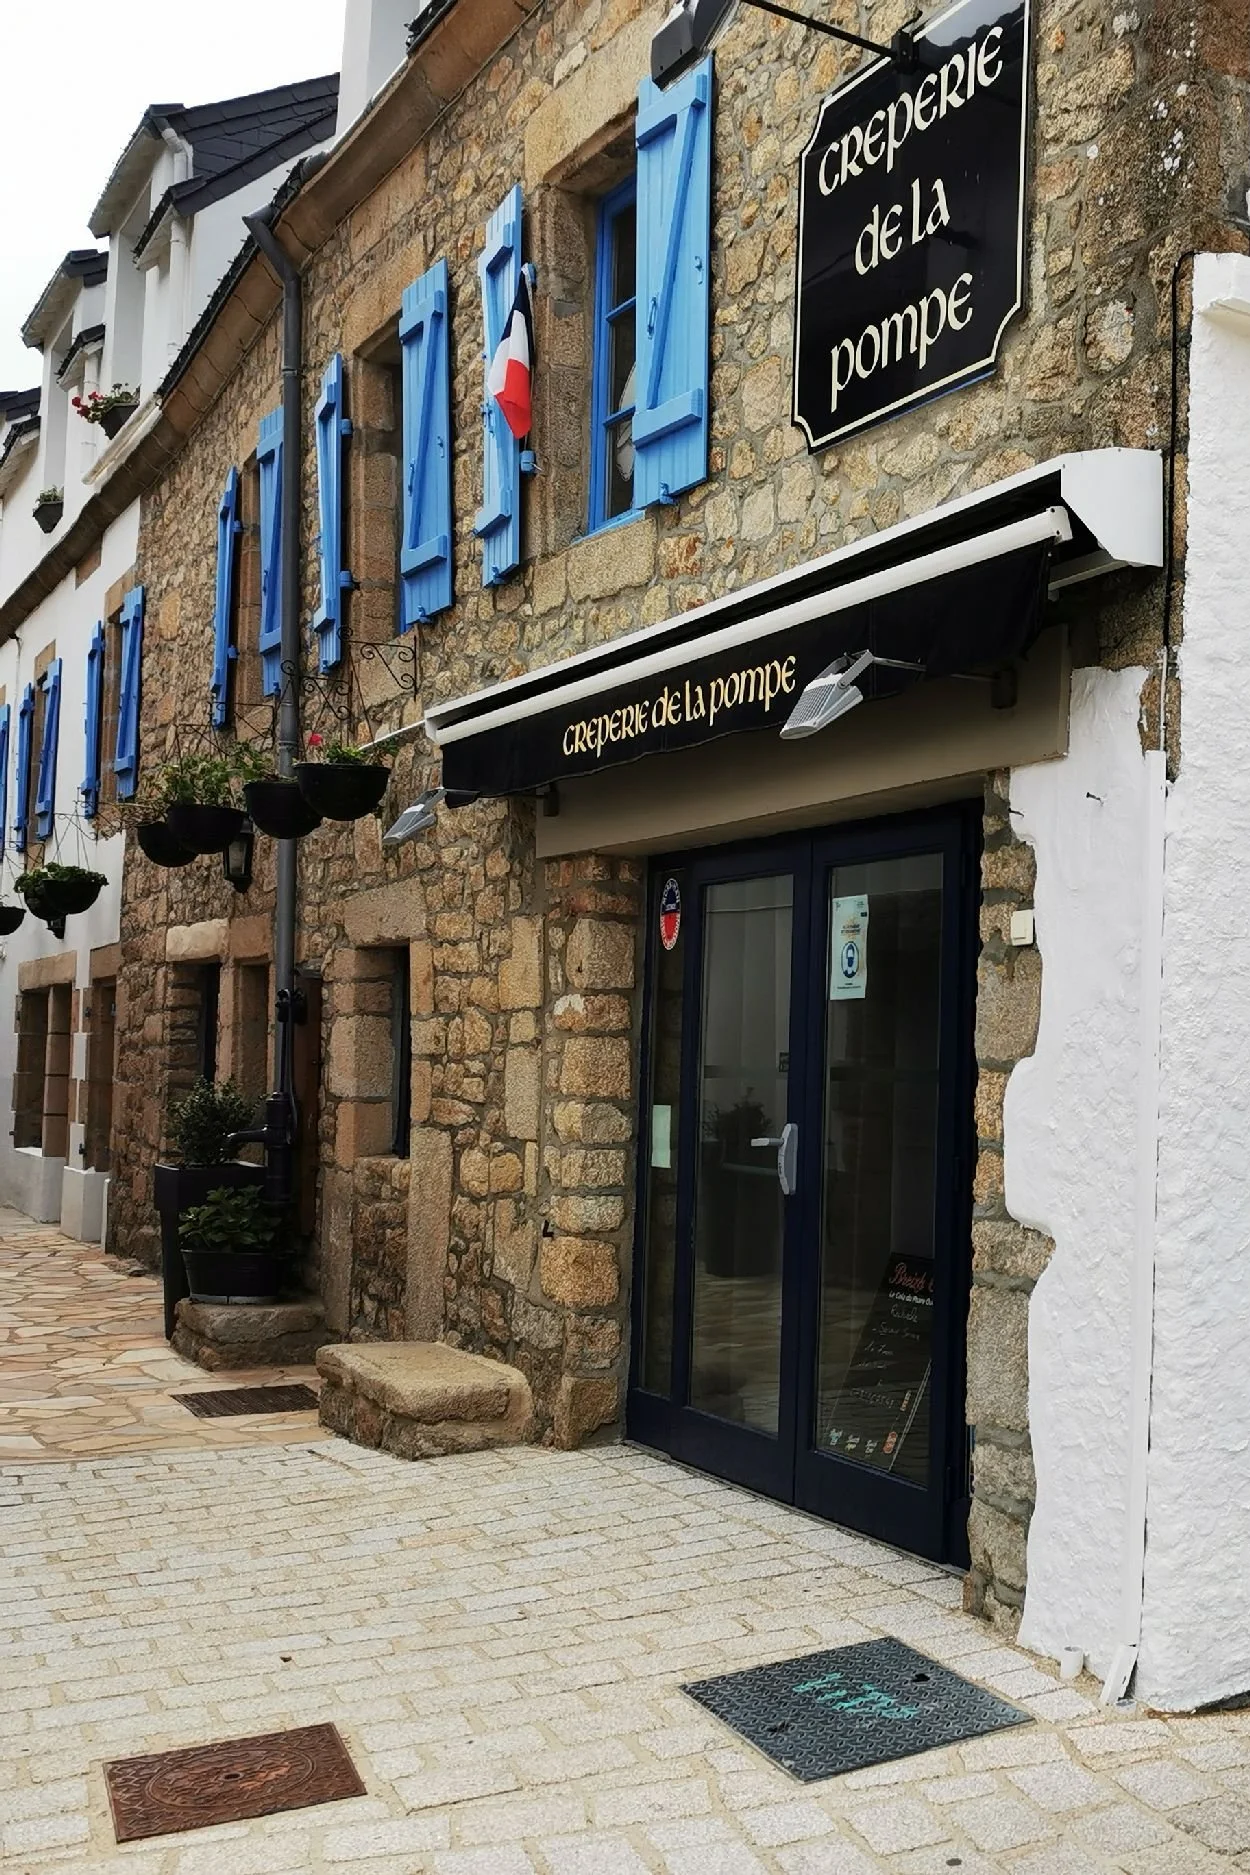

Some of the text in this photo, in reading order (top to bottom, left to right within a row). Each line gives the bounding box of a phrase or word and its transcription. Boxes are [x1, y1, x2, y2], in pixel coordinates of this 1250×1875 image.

[818, 26, 1004, 196] CREPERIE
[854, 178, 951, 275] de la
[830, 272, 973, 413] pompe
[562, 655, 796, 758] CREPERIE de la pompe
